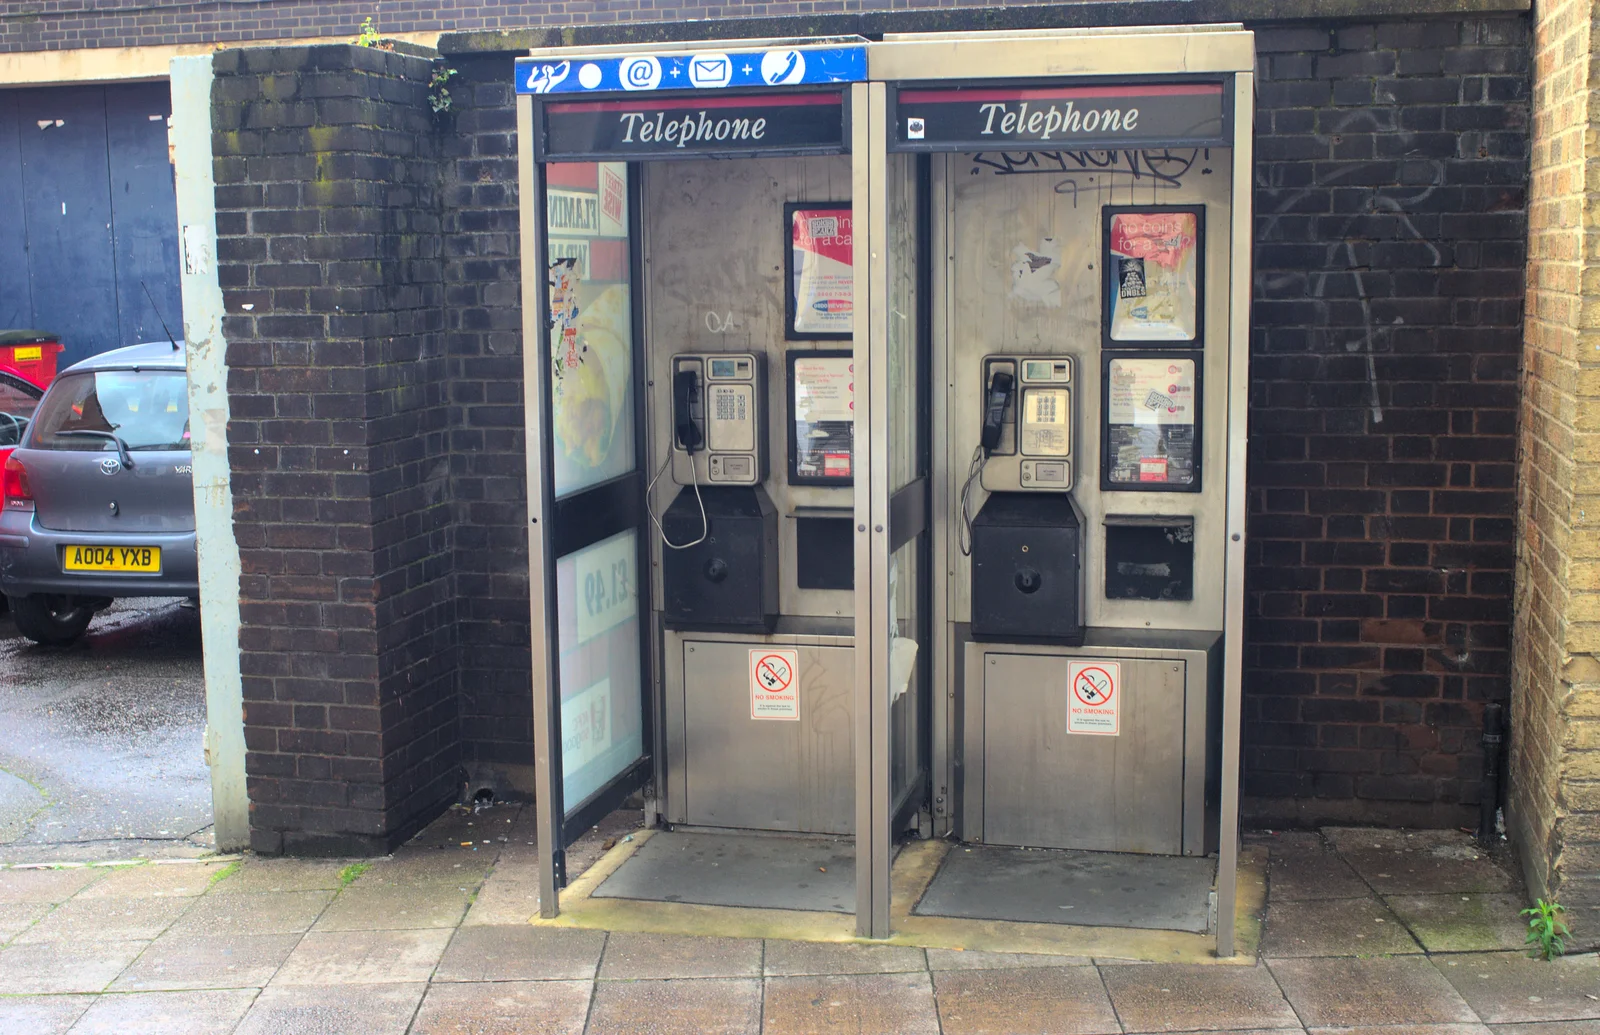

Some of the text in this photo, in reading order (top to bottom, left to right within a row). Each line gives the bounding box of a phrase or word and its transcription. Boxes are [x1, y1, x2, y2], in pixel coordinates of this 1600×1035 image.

[620, 111, 766, 147] Telephone
[979, 101, 1138, 139] Telephone
[1118, 220, 1182, 234] no coins
[1118, 237, 1138, 251] for
[1142, 240, 1152, 251] a
[120, 548, 151, 566] YXB
